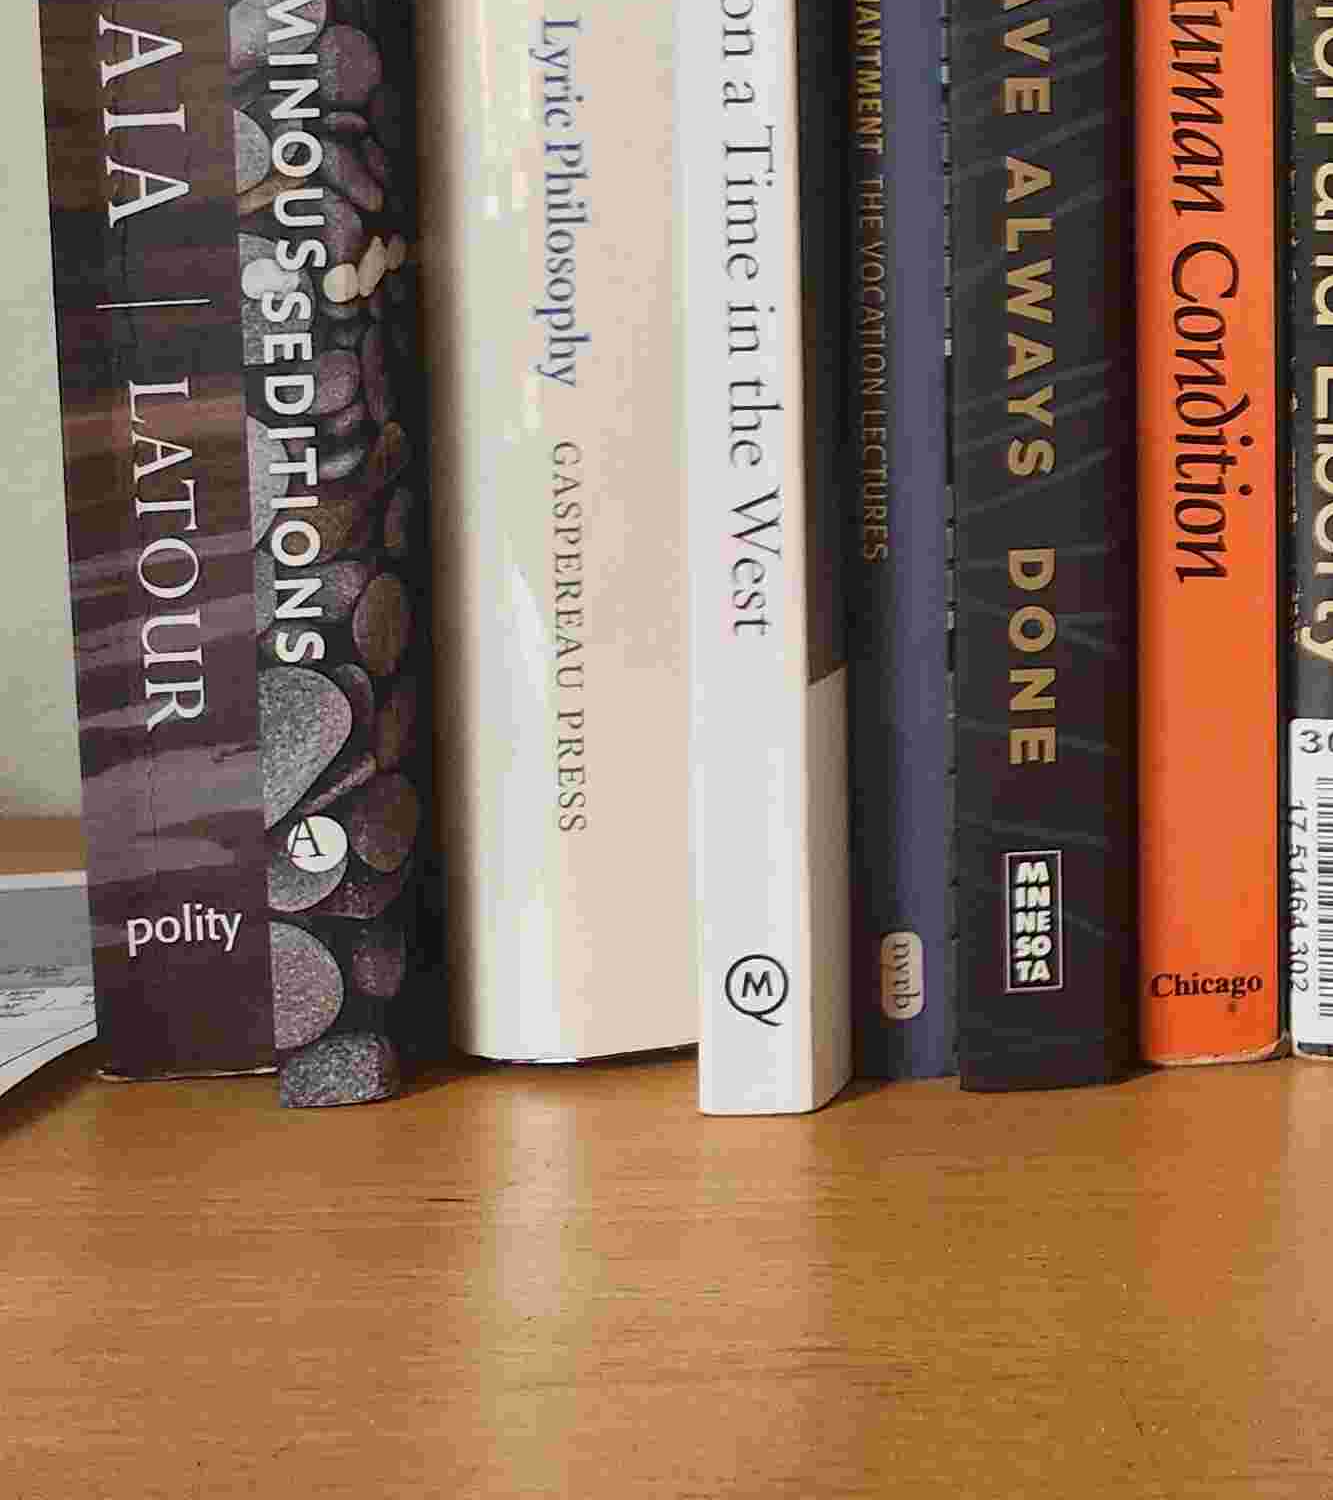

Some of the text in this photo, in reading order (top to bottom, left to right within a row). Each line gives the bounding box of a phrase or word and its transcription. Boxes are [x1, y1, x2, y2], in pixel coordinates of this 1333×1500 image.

[531, 18, 595, 387] Lyric Philosophy
[722, 83, 753, 108] a
[726, 126, 777, 280] Time
[727, 298, 777, 357] in
[728, 378, 784, 466] the
[858, 175, 888, 563] THE VOCATION LECTURES
[1004, 155, 1055, 477] ALWAYS
[1170, 240, 1251, 582] Condition
[127, 379, 207, 733] LATOUR
[262, 289, 323, 664] SEDITIONS
[727, 486, 784, 636] West
[551, 441, 586, 834] GASPEREAU PRESS
[1008, 548, 1057, 765] DONE
[126, 902, 242, 956] polity
[1151, 968, 1262, 999] Chicago
